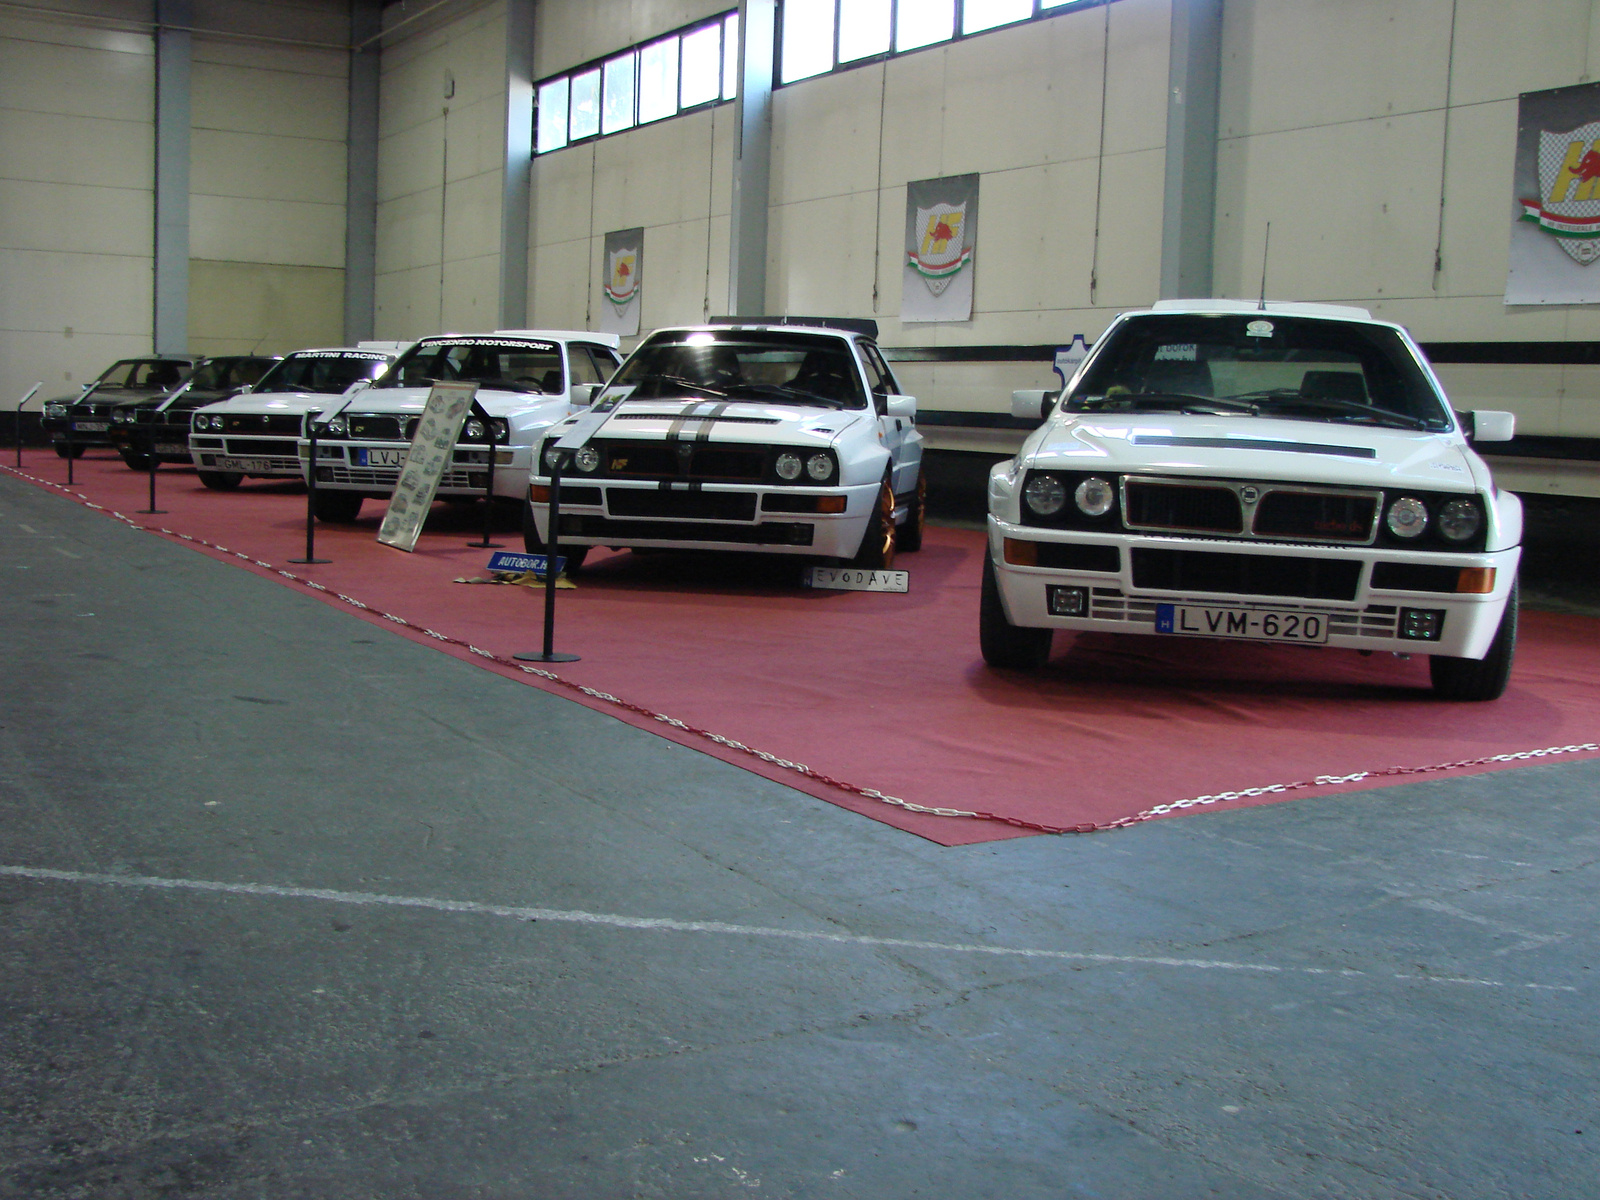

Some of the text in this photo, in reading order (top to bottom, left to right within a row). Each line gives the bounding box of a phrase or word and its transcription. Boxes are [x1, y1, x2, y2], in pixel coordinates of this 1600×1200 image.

[921, 212, 963, 256] HF
[421, 339, 554, 351] VINCENZO MOTORSPORT
[343, 352, 388, 361] RACING
[224, 459, 271, 470] GML-176
[1161, 620, 1170, 628] H
[1180, 609, 1320, 639] LVM-620
